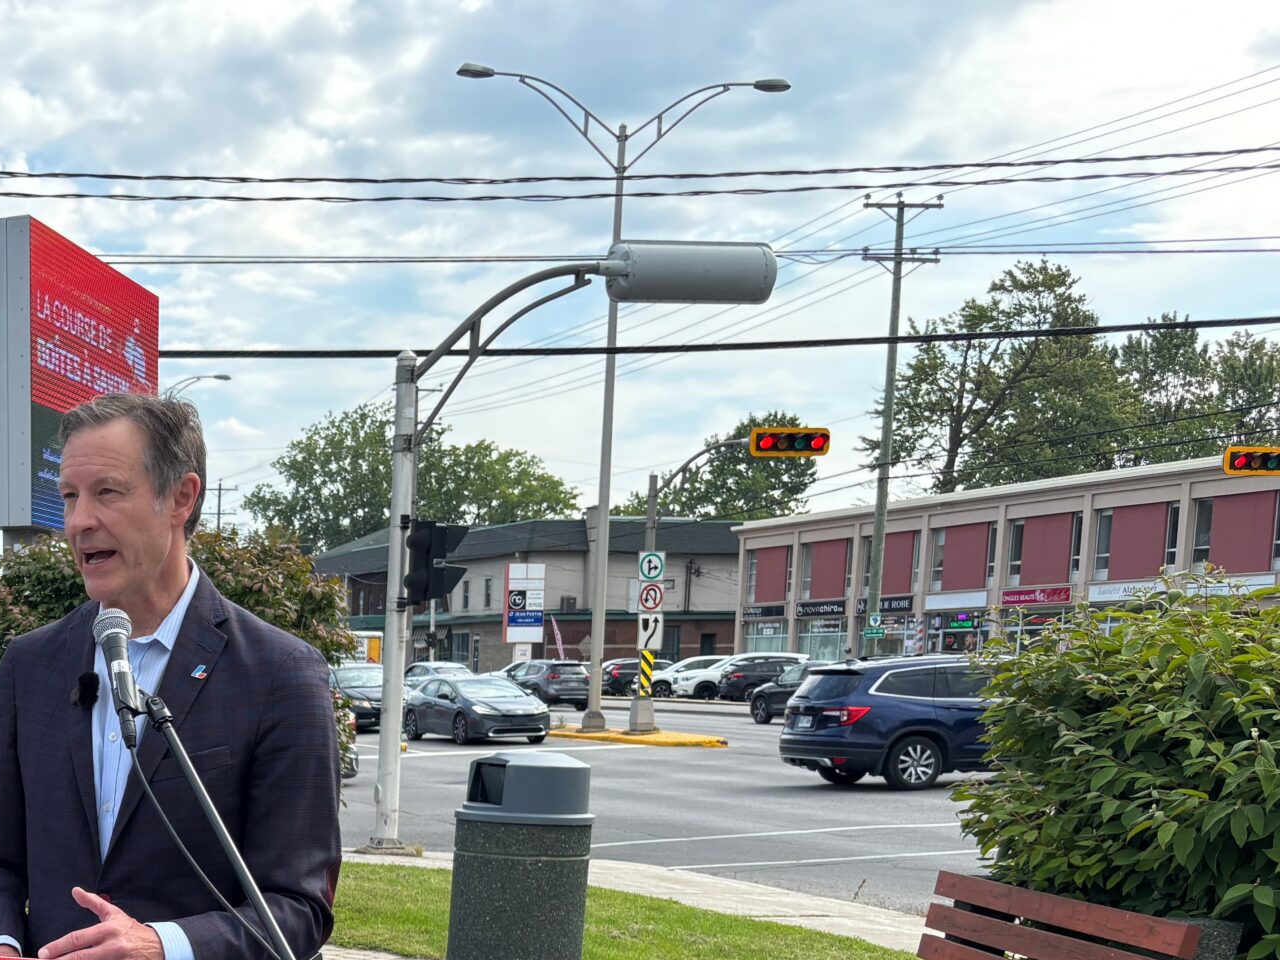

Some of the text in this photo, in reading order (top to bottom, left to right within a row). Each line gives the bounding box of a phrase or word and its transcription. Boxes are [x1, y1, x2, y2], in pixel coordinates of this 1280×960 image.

[36, 290, 52, 322] LA
[53, 300, 98, 346] COURSE
[891, 599, 910, 609] ROBE
